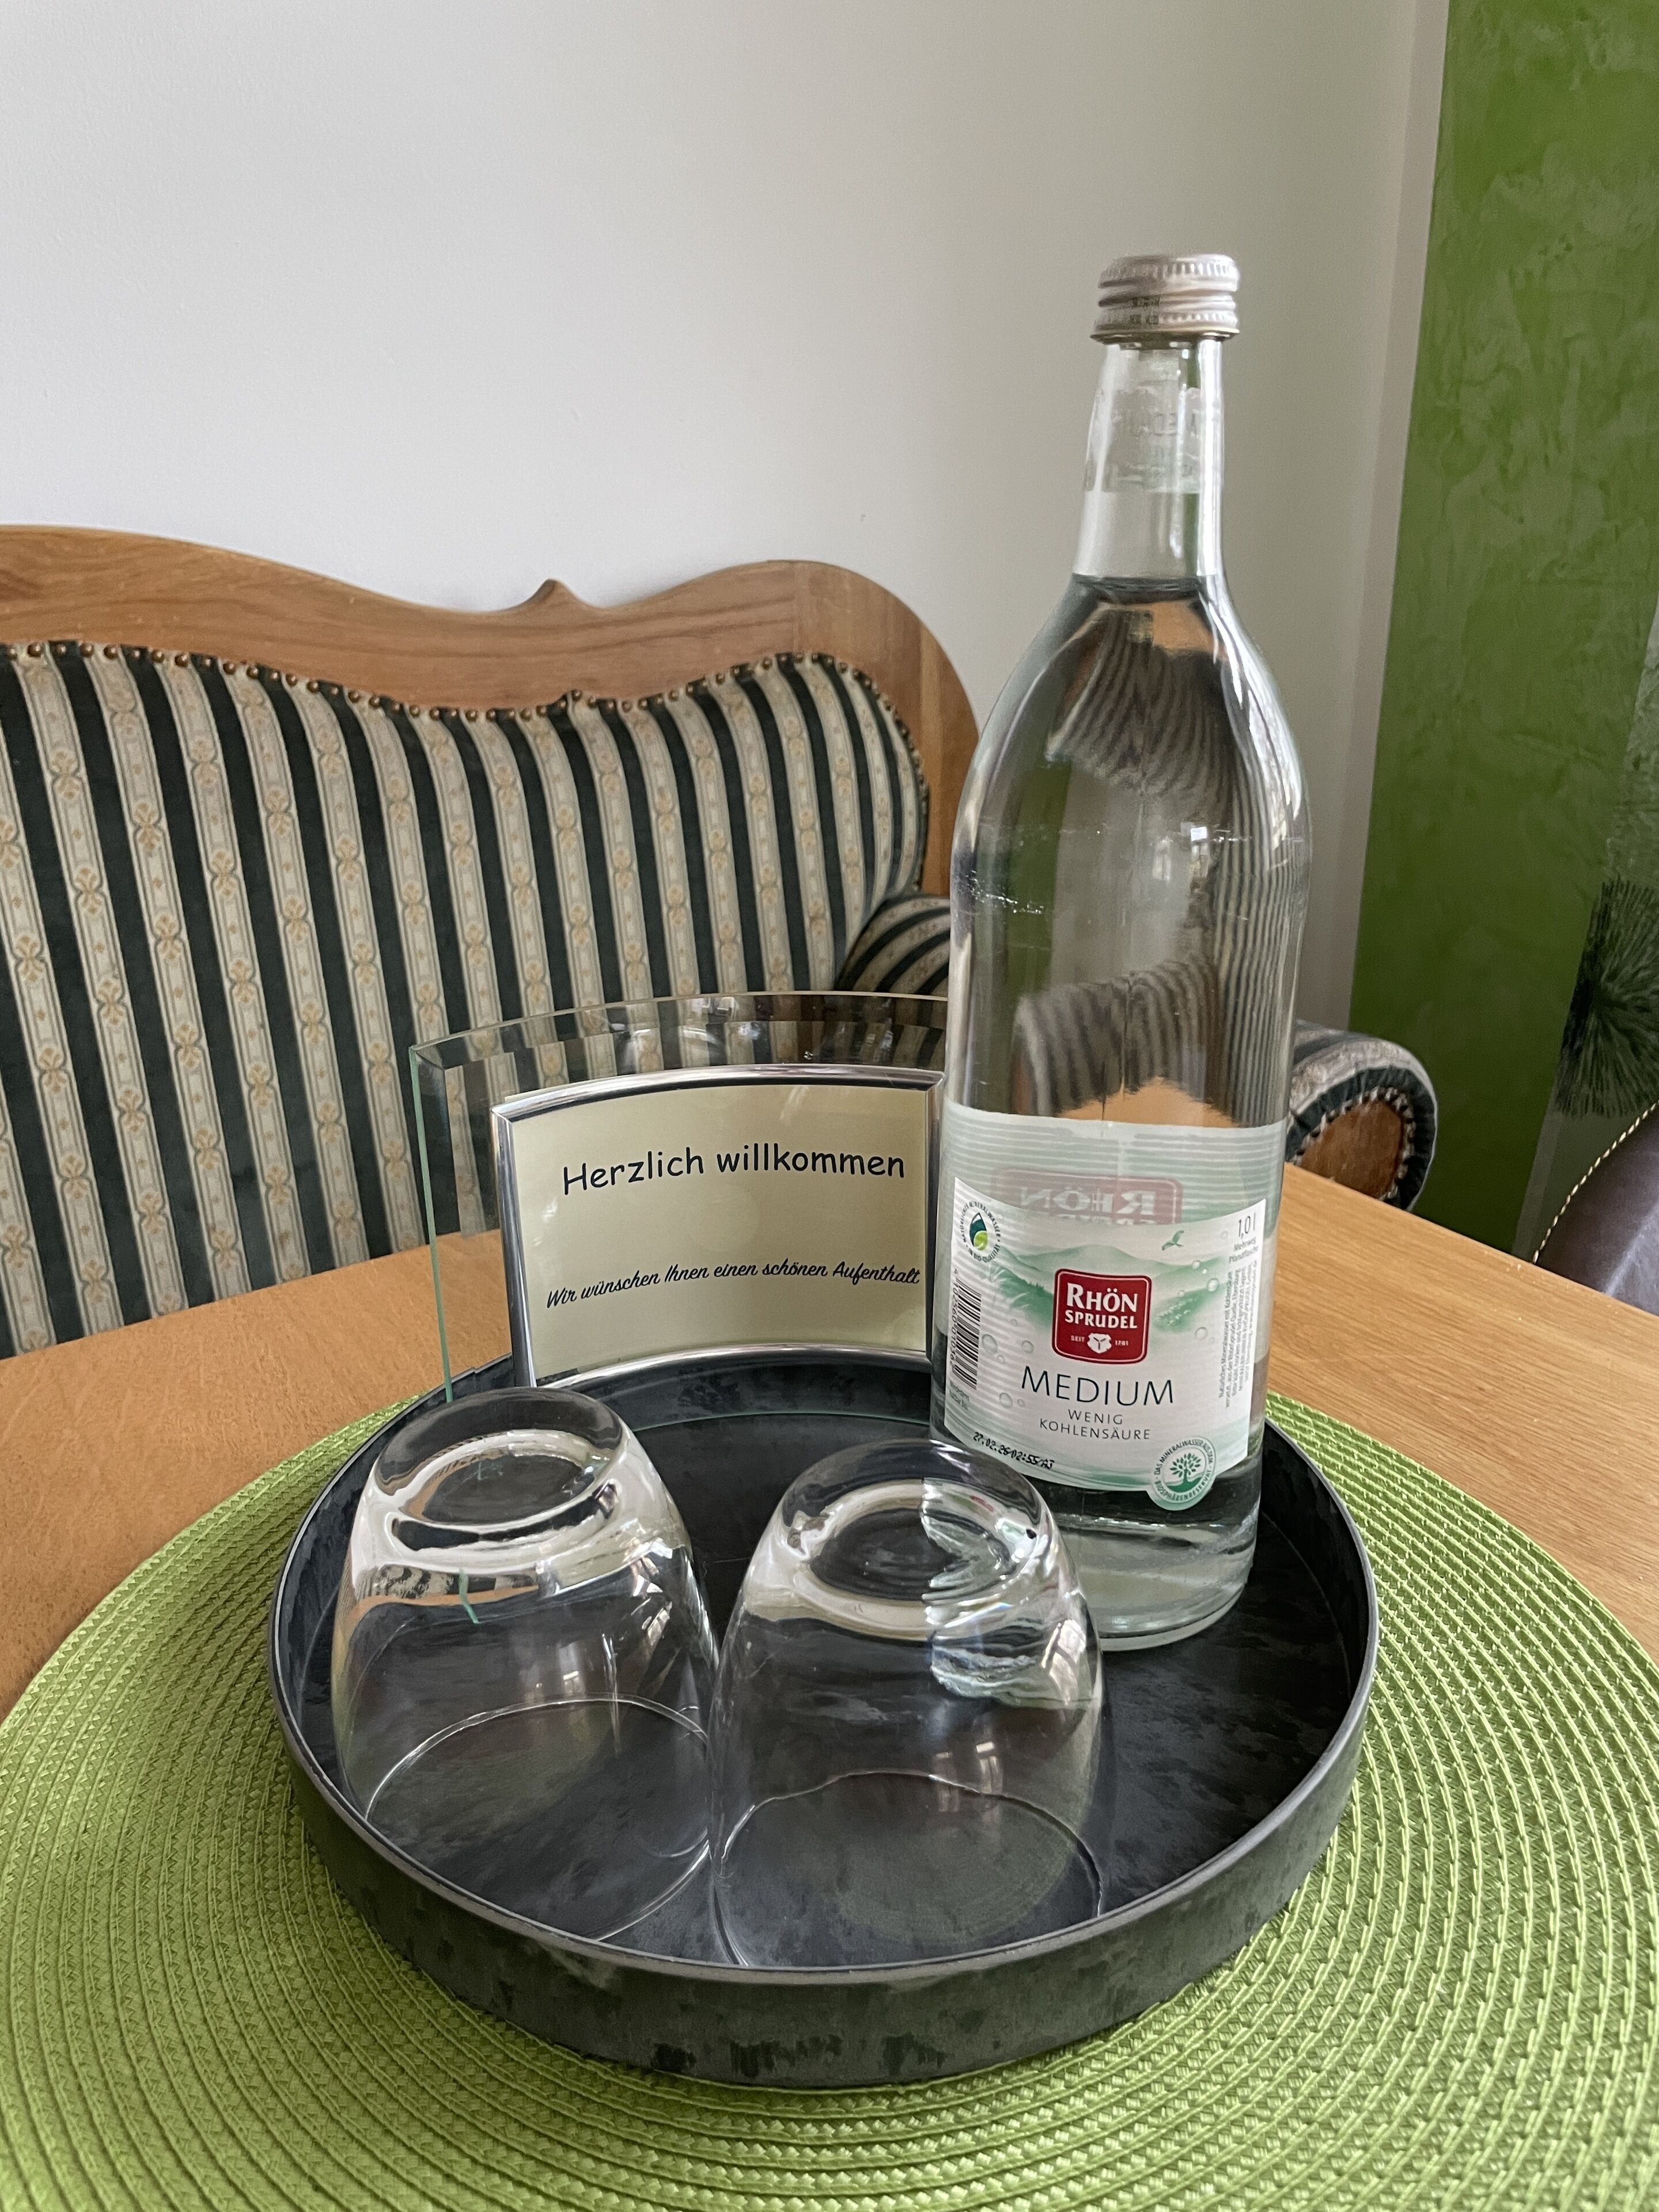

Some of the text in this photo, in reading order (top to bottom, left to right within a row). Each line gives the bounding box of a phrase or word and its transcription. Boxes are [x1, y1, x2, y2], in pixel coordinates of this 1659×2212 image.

[563, 1142, 904, 1195] Herzlich willkommen
[547, 1258, 921, 1309] Wir wünschen Ihnen einen schönen Aufenthalt
[1066, 1282, 1138, 1313] RHÖN
[1065, 1309, 1138, 1329] SPRUDEL
[1021, 1366, 1173, 1406] MEDIUM
[1040, 1418, 1151, 1440] KOHLENSÄURE
[1067, 1409, 1123, 1425] WENIG
